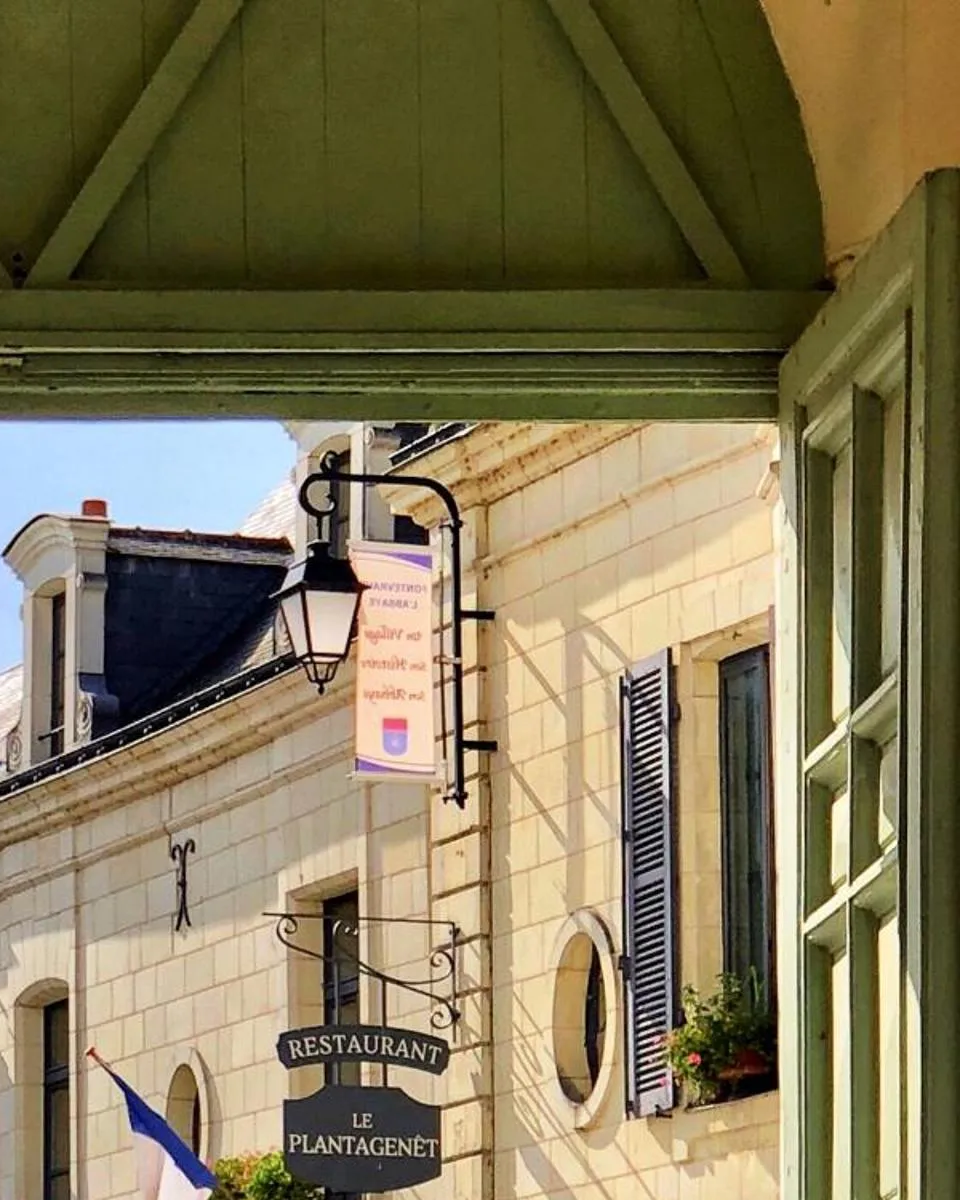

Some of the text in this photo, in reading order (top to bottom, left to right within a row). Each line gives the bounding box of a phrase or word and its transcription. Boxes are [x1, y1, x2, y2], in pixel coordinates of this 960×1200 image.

[288, 1034, 442, 1065] RESTAURANT
[352, 1113, 373, 1129] LE
[289, 1134, 439, 1158] PLANTAGENÊT
